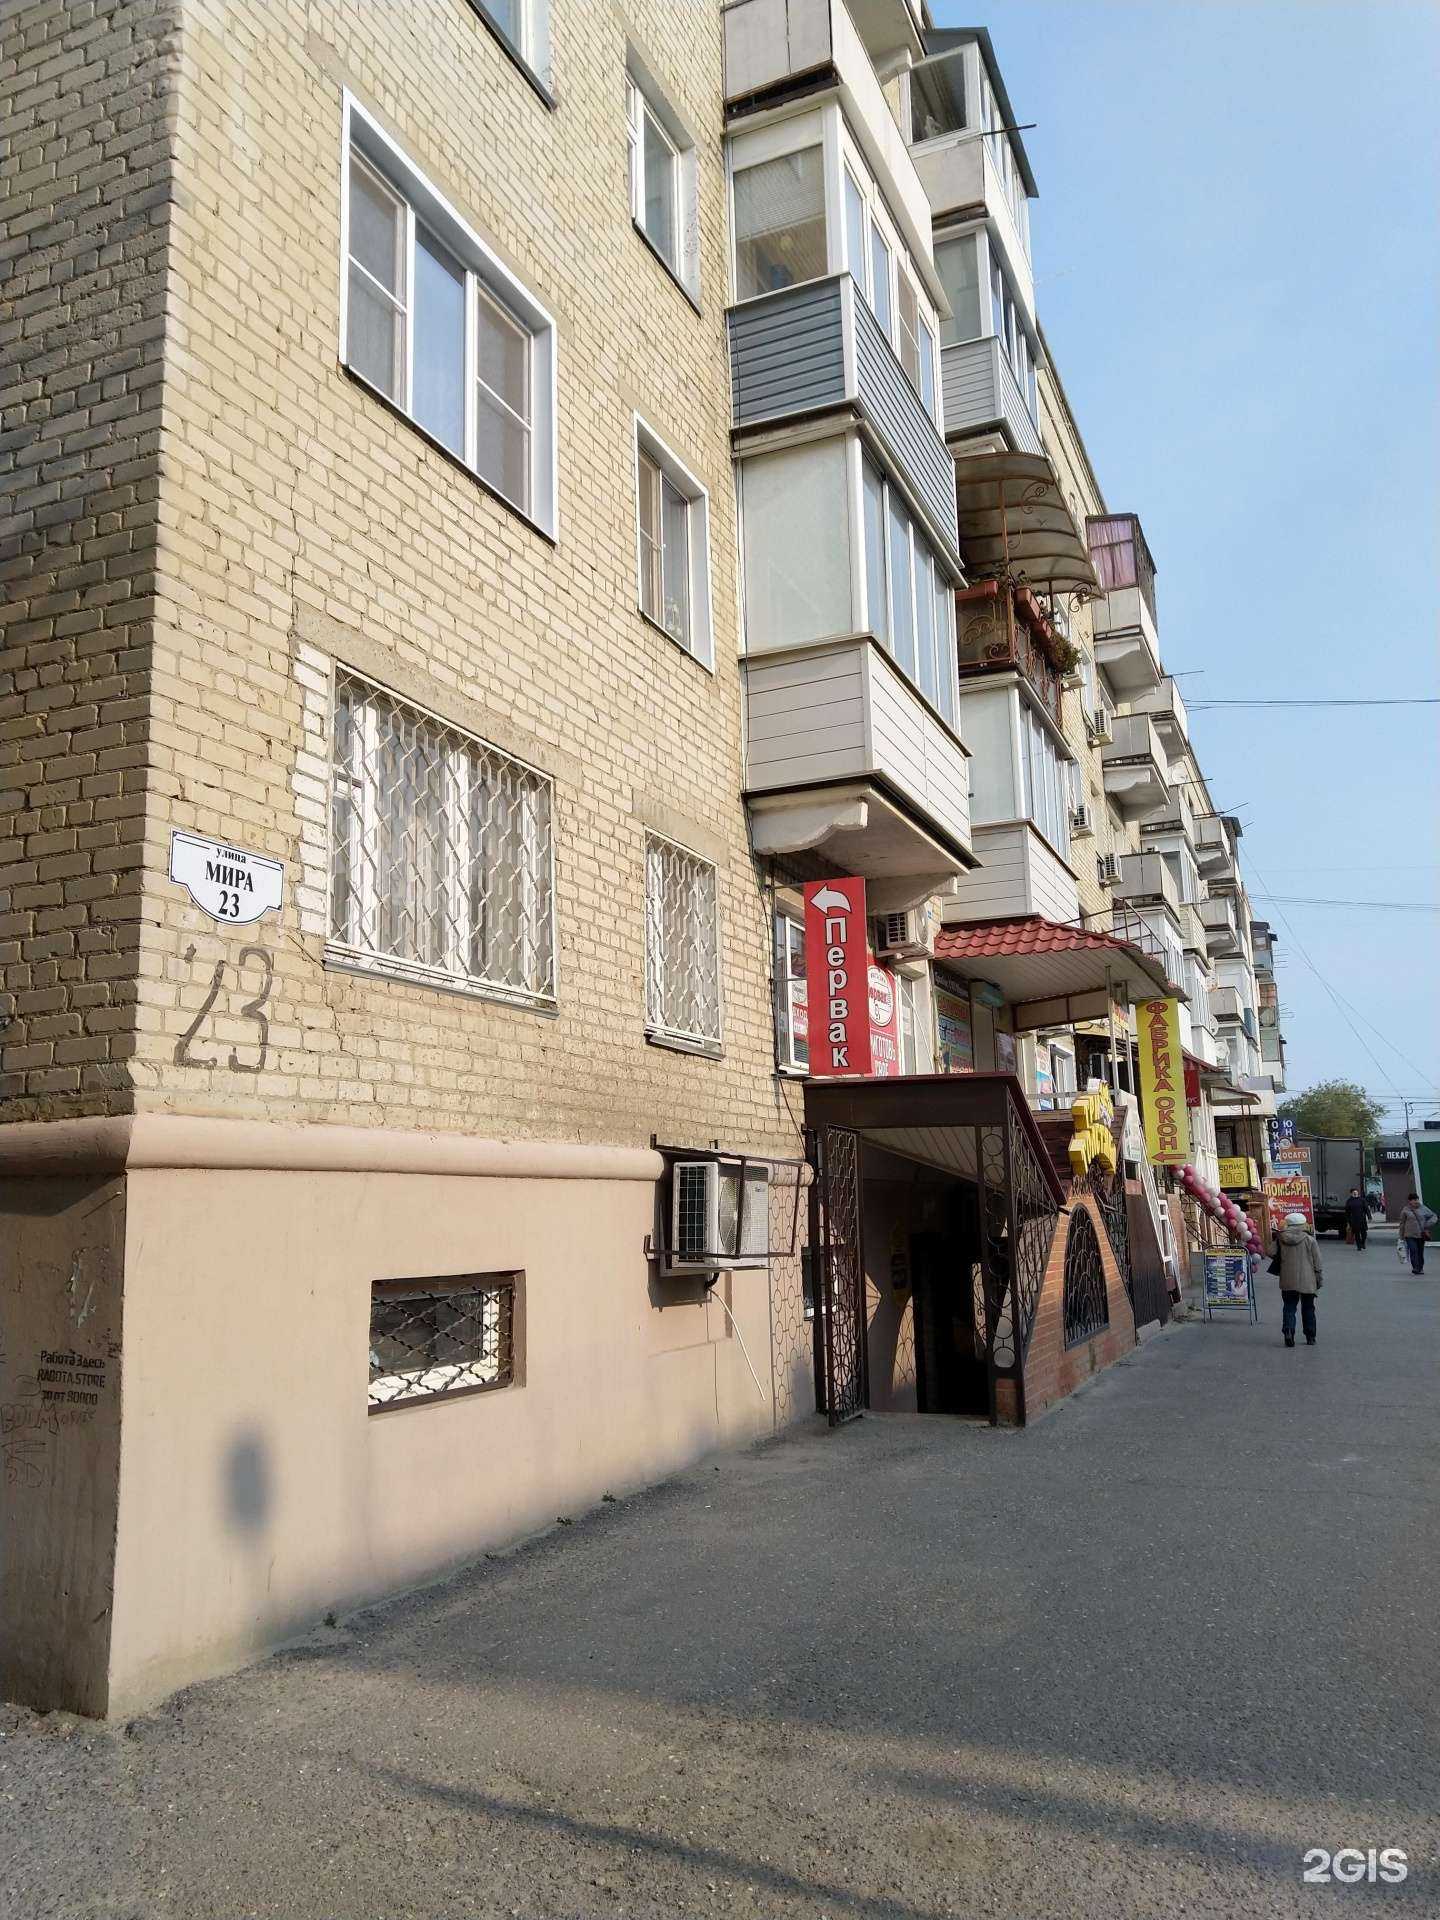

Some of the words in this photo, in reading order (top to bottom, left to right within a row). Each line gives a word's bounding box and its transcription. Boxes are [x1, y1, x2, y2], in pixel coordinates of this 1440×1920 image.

[216, 847, 247, 864] улица
[205, 860, 254, 893] МИРА
[218, 890, 241, 918] 23
[825, 916, 850, 1068] Первак
[173, 943, 274, 1073] 23
[1145, 1001, 1176, 1093] ФАБРИКА
[1155, 1096, 1178, 1151] ОКОН
[1271, 1121, 1281, 1161] ОКНА
[1281, 1151, 1308, 1159] ОСАГО
[1264, 1181, 1310, 1198] ЛОМБАРД
[41, 1350, 75, 1366] Работа
[76, 1354, 105, 1369] Здесь
[37, 1368, 106, 1388] RABOTA.STORE
